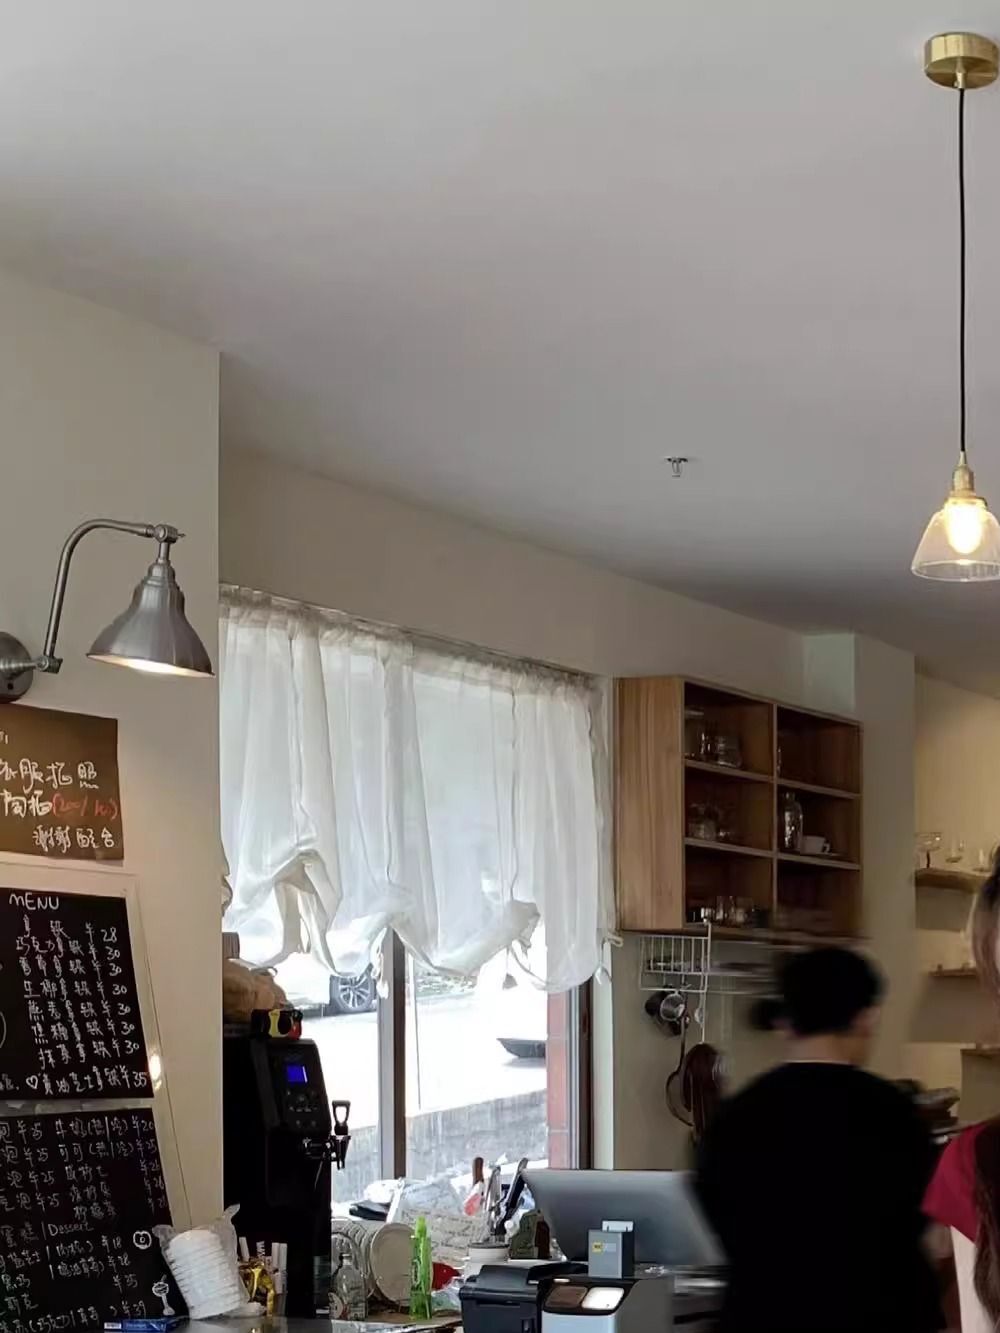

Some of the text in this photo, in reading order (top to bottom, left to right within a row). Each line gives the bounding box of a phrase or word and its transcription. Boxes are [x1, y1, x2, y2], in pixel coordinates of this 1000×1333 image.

[33, 824, 115, 853] 谢谢配合
[47, 1221, 95, 1236] Dessert
